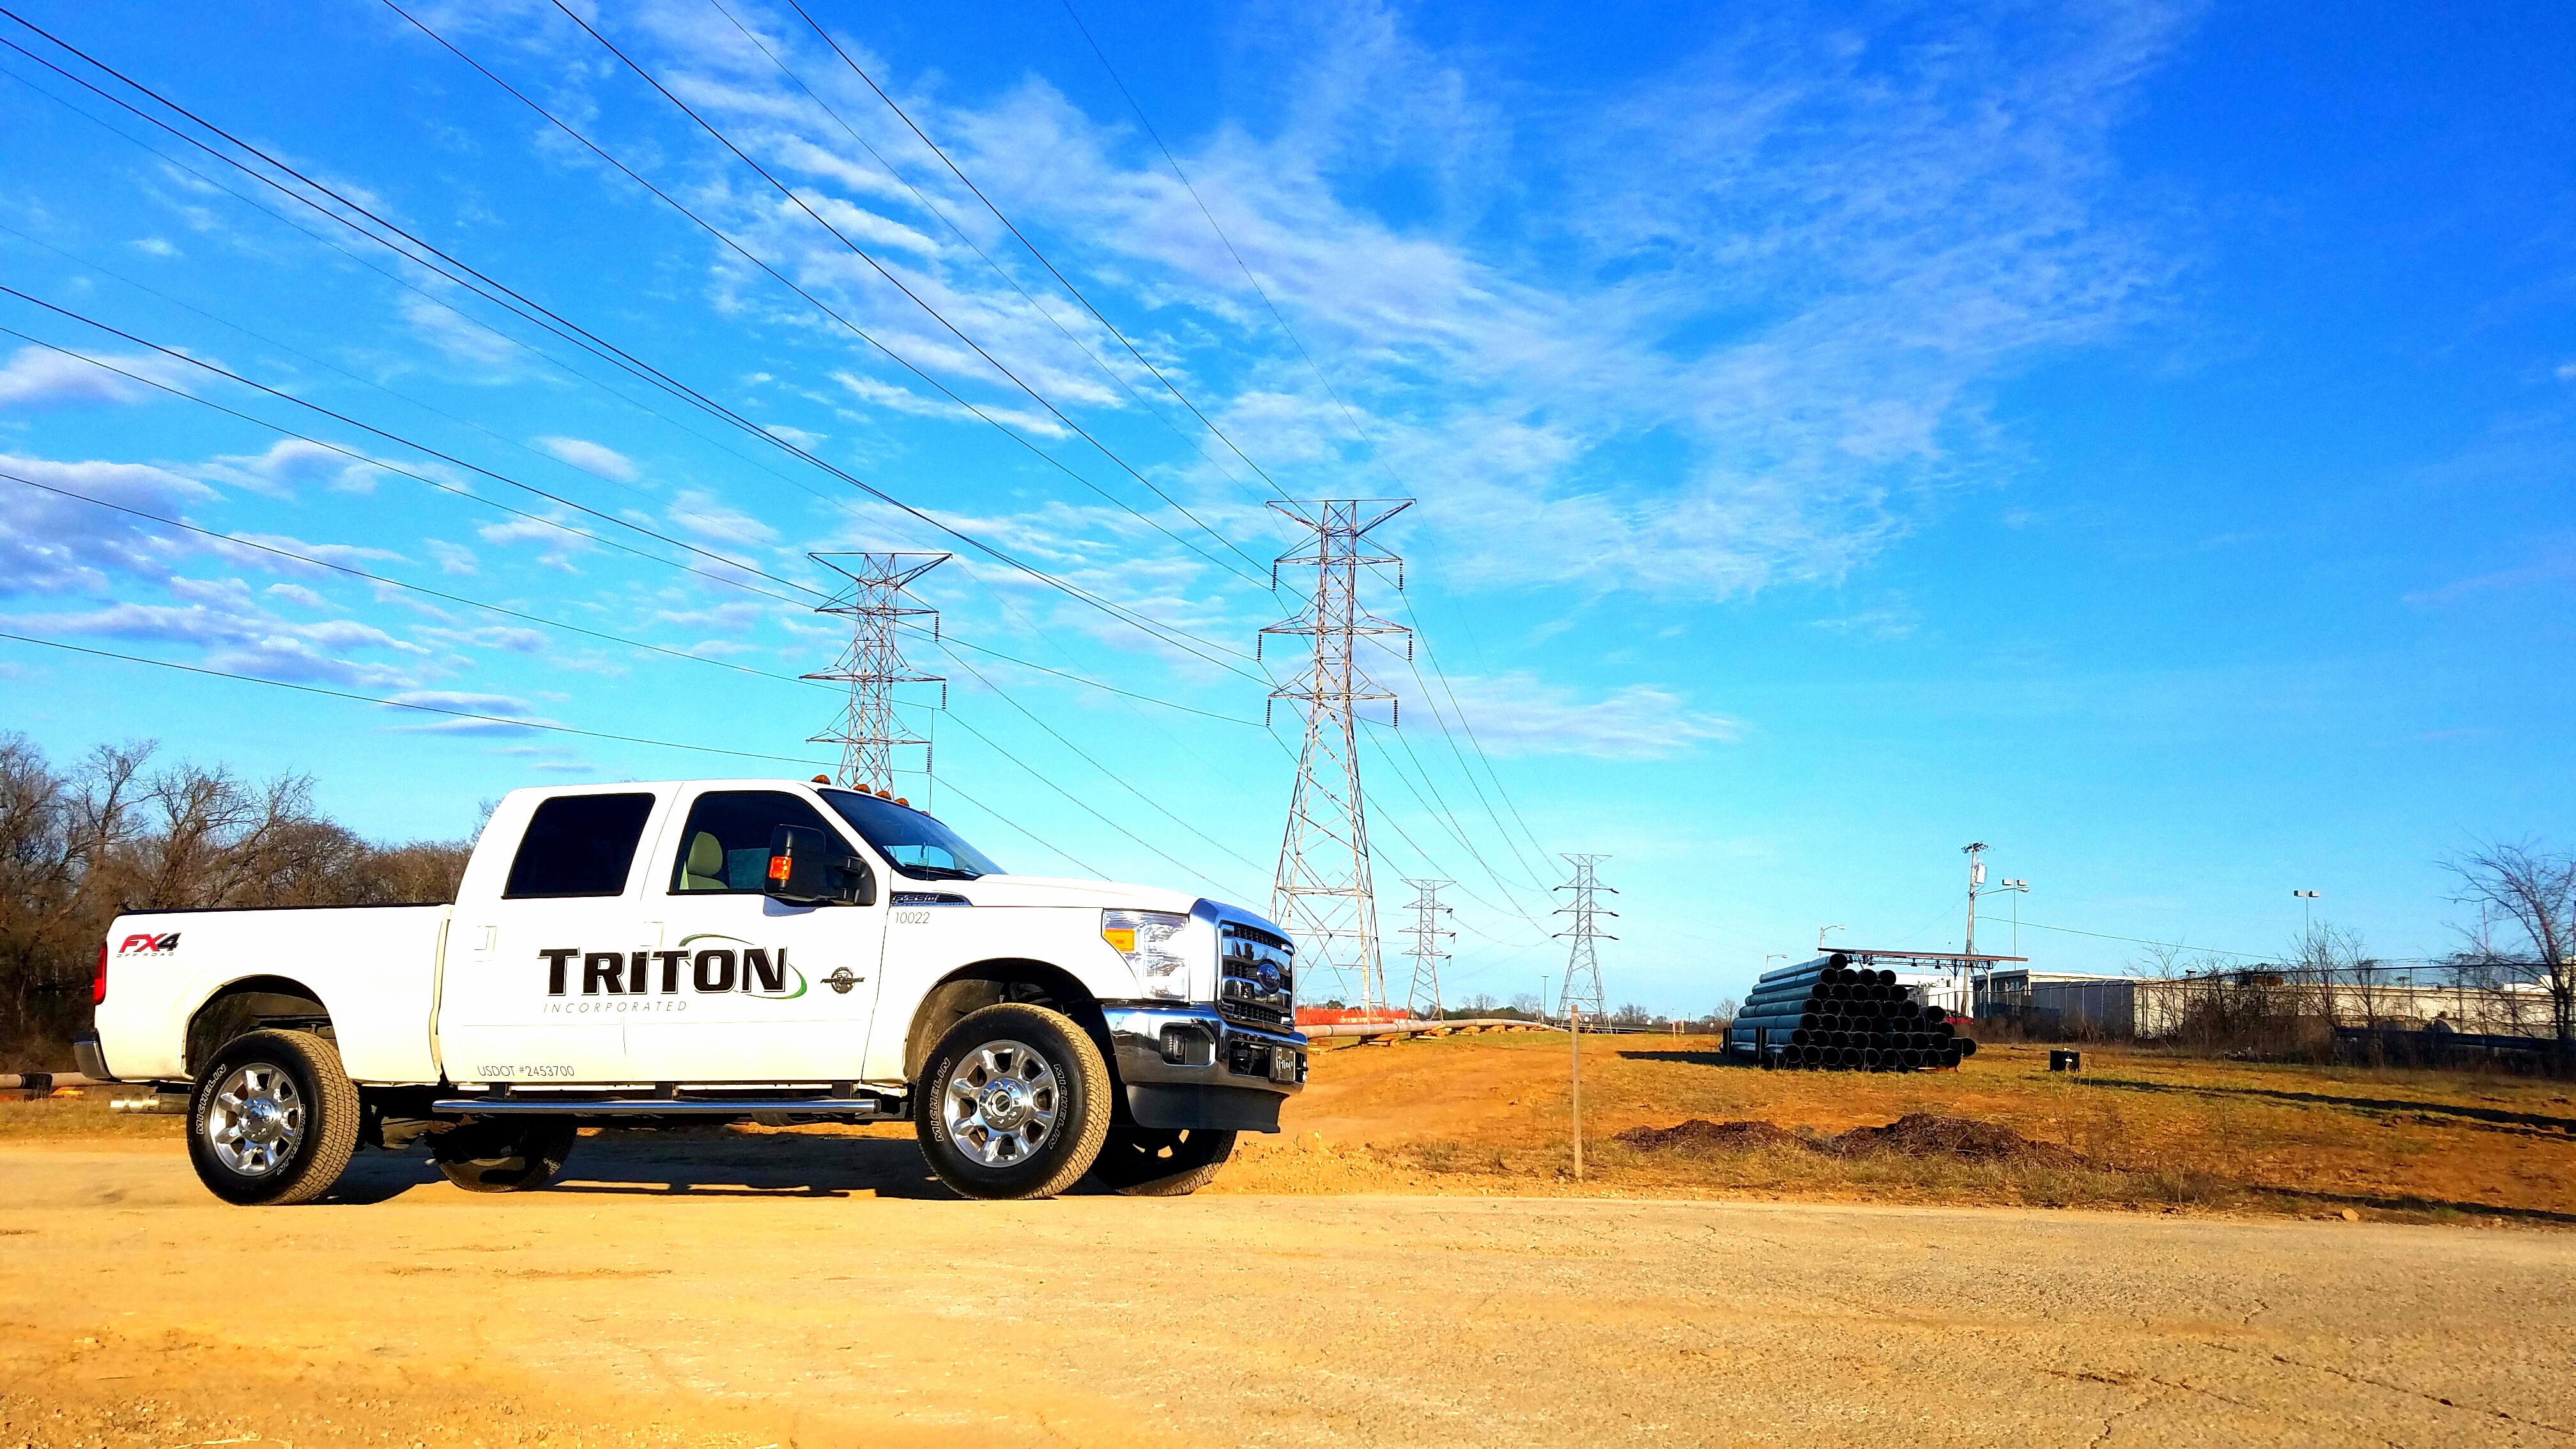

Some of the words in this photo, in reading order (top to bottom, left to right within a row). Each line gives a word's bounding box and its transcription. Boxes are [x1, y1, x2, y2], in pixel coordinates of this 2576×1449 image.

[118, 932, 181, 953] FX4
[896, 912, 930, 924] 10022
[537, 946, 788, 997] TRITON
[543, 1000, 687, 1013] INCORPORATED
[477, 1066, 515, 1077] USDOT
[519, 1066, 574, 1077] #2453700
[195, 1064, 227, 1135] MICHELIN
[929, 1057, 951, 1142] MICHELIN
[1048, 1063, 1068, 1149] MICHELIN
[277, 1103, 306, 1176] MICHELIN
